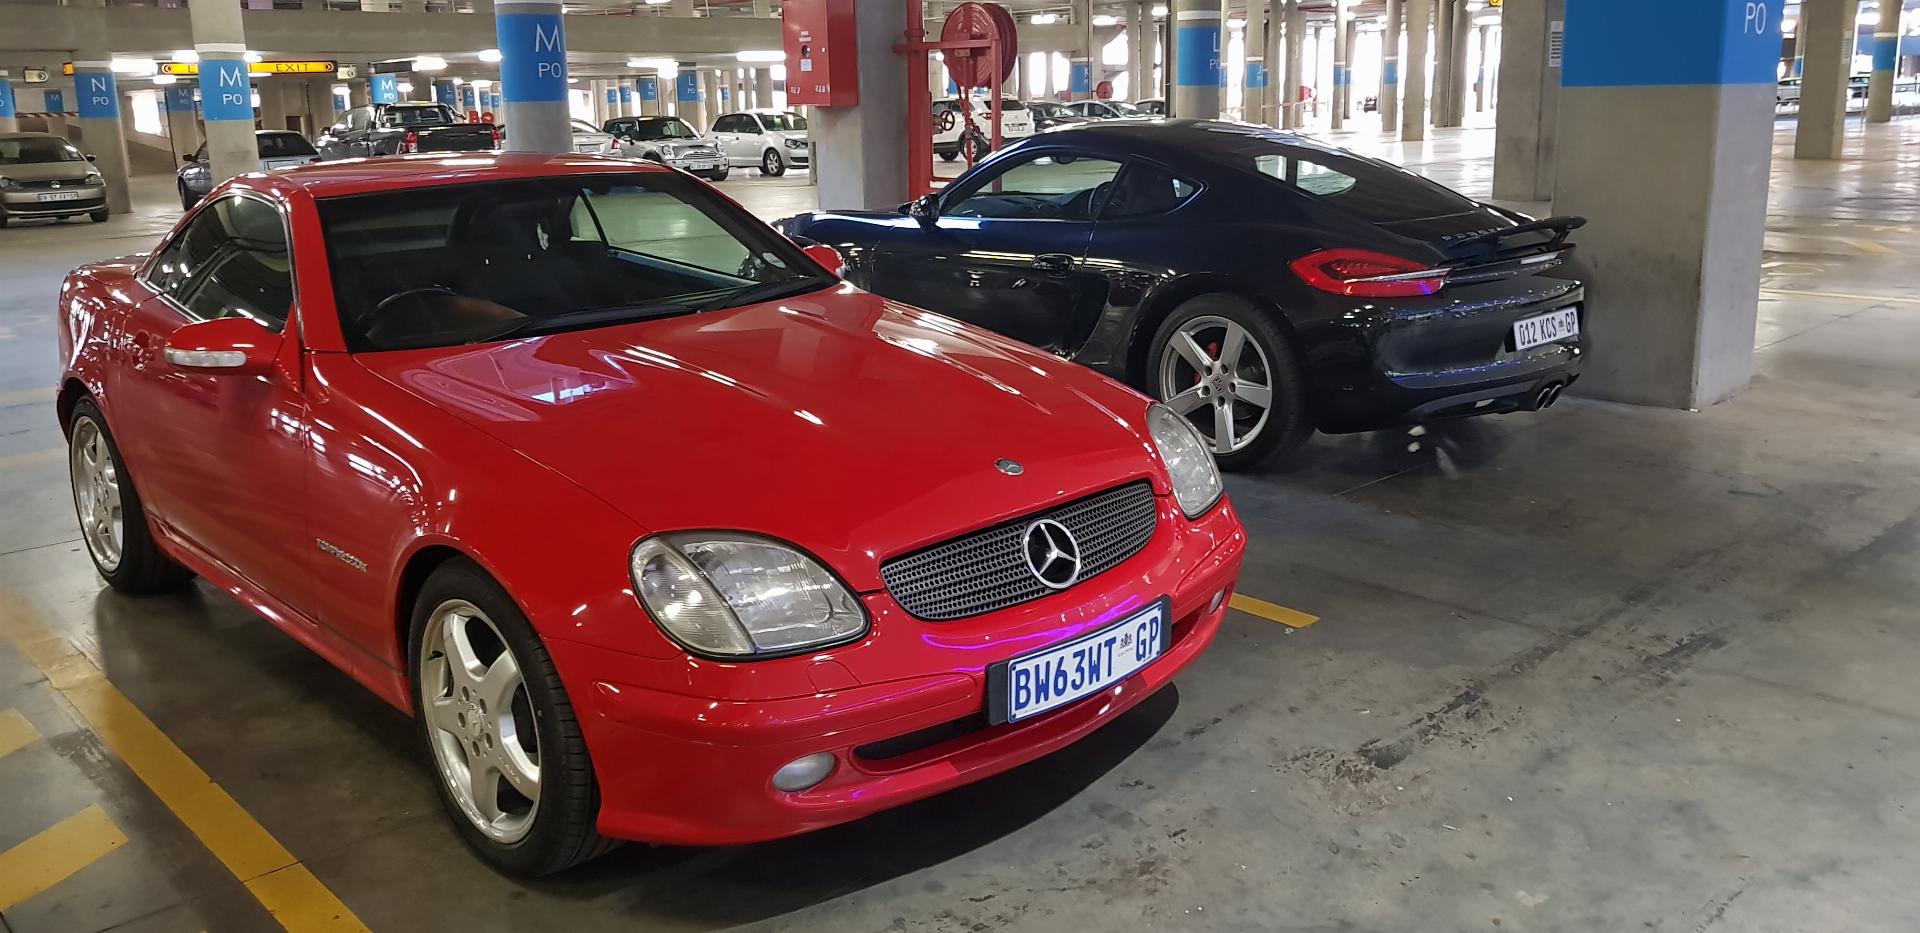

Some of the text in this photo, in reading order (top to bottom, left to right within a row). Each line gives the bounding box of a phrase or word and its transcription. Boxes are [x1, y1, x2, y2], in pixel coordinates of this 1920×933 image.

[535, 22, 561, 52] M
[1213, 32, 1221, 52] L
[275, 63, 309, 72] EXIT
[219, 66, 242, 87] M
[688, 75, 694, 86] L
[91, 77, 106, 92] N
[381, 79, 394, 90] M
[648, 82, 654, 90] K
[178, 89, 188, 97] M
[1519, 311, 1576, 346] 012 KCS GP
[1014, 616, 1159, 711] BW63WT GP
